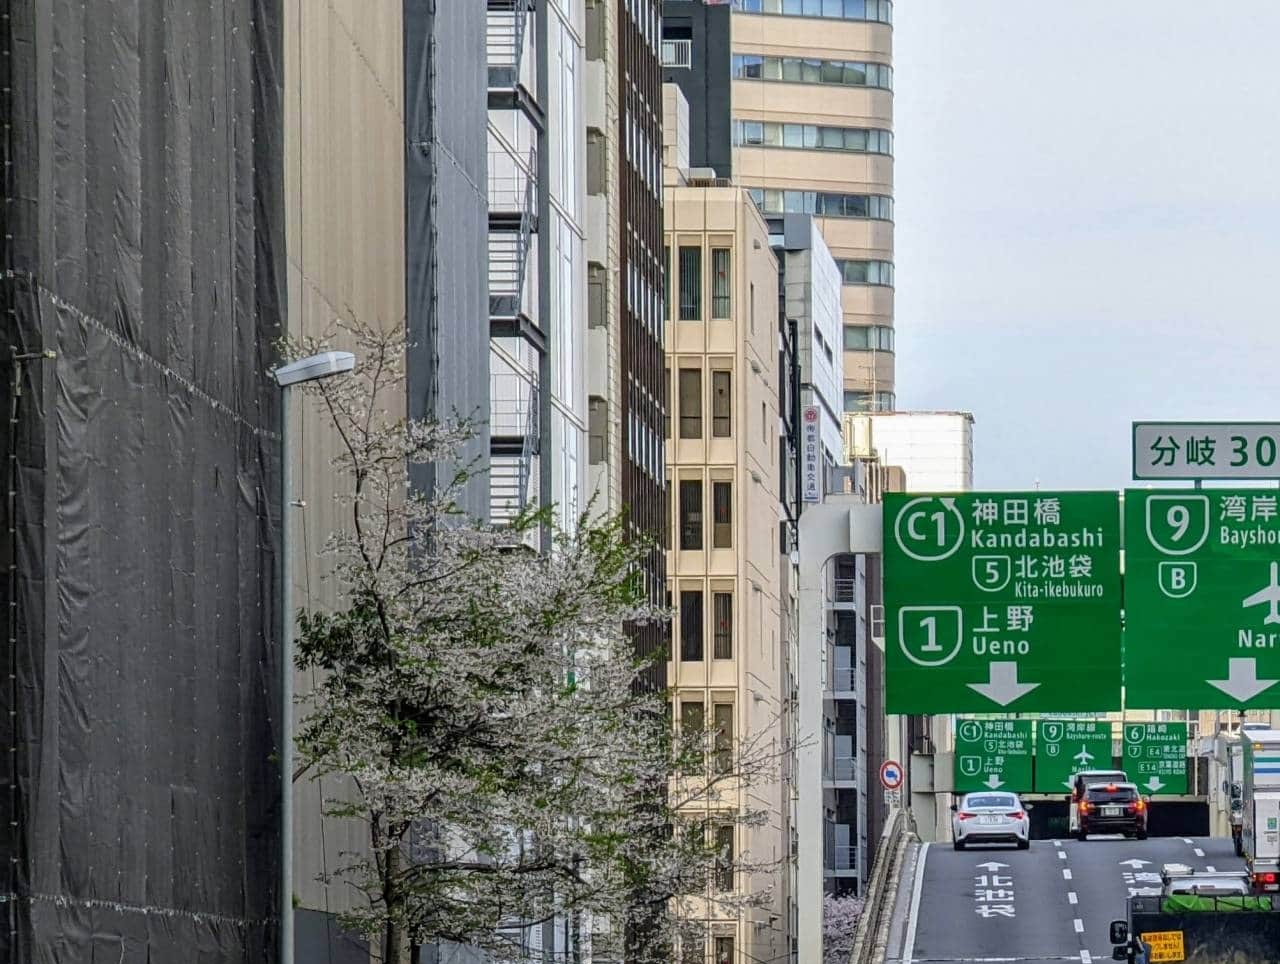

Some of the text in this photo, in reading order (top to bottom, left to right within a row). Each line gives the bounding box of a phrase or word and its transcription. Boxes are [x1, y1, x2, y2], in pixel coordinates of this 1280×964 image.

[1150, 436, 1216, 466] 分岐
[972, 498, 1060, 526] 神田橋
[1166, 505, 1190, 542] 9
[907, 511, 946, 546] C1
[971, 527, 1103, 548] Kandabashi
[985, 561, 999, 583] 5
[1015, 554, 1093, 578] 北池袋
[1015, 582, 1104, 598] Kita-ikebukuro
[1171, 568, 1186, 590] B
[972, 606, 1034, 632] 上野
[919, 616, 943, 651] 1
[972, 636, 1030, 655] Ueno
[1049, 725, 1057, 738] 9
[1131, 727, 1139, 740] 6
[967, 759, 975, 771] 1
[974, 874, 1016, 918] 北池袋
